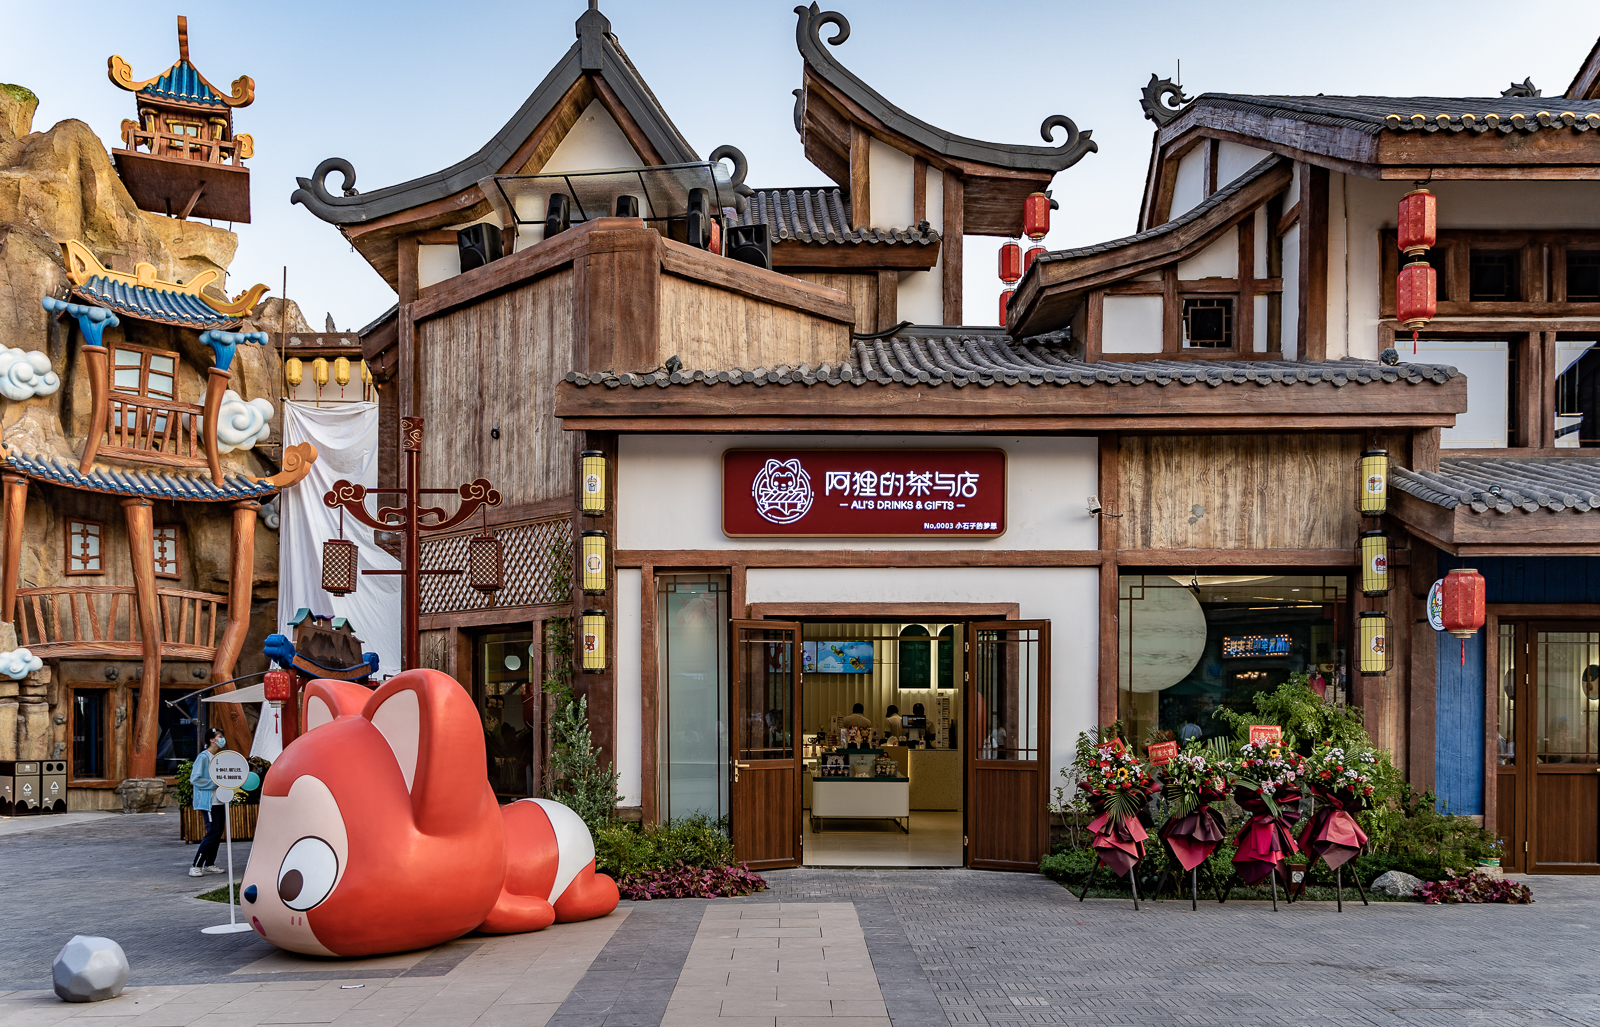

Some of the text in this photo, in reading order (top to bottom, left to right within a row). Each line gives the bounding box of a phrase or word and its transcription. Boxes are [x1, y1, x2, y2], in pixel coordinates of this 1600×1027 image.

[825, 470, 980, 498] 阿狸的茶与店
[850, 500, 955, 510] ALI'S DRINKS & GIFTS
